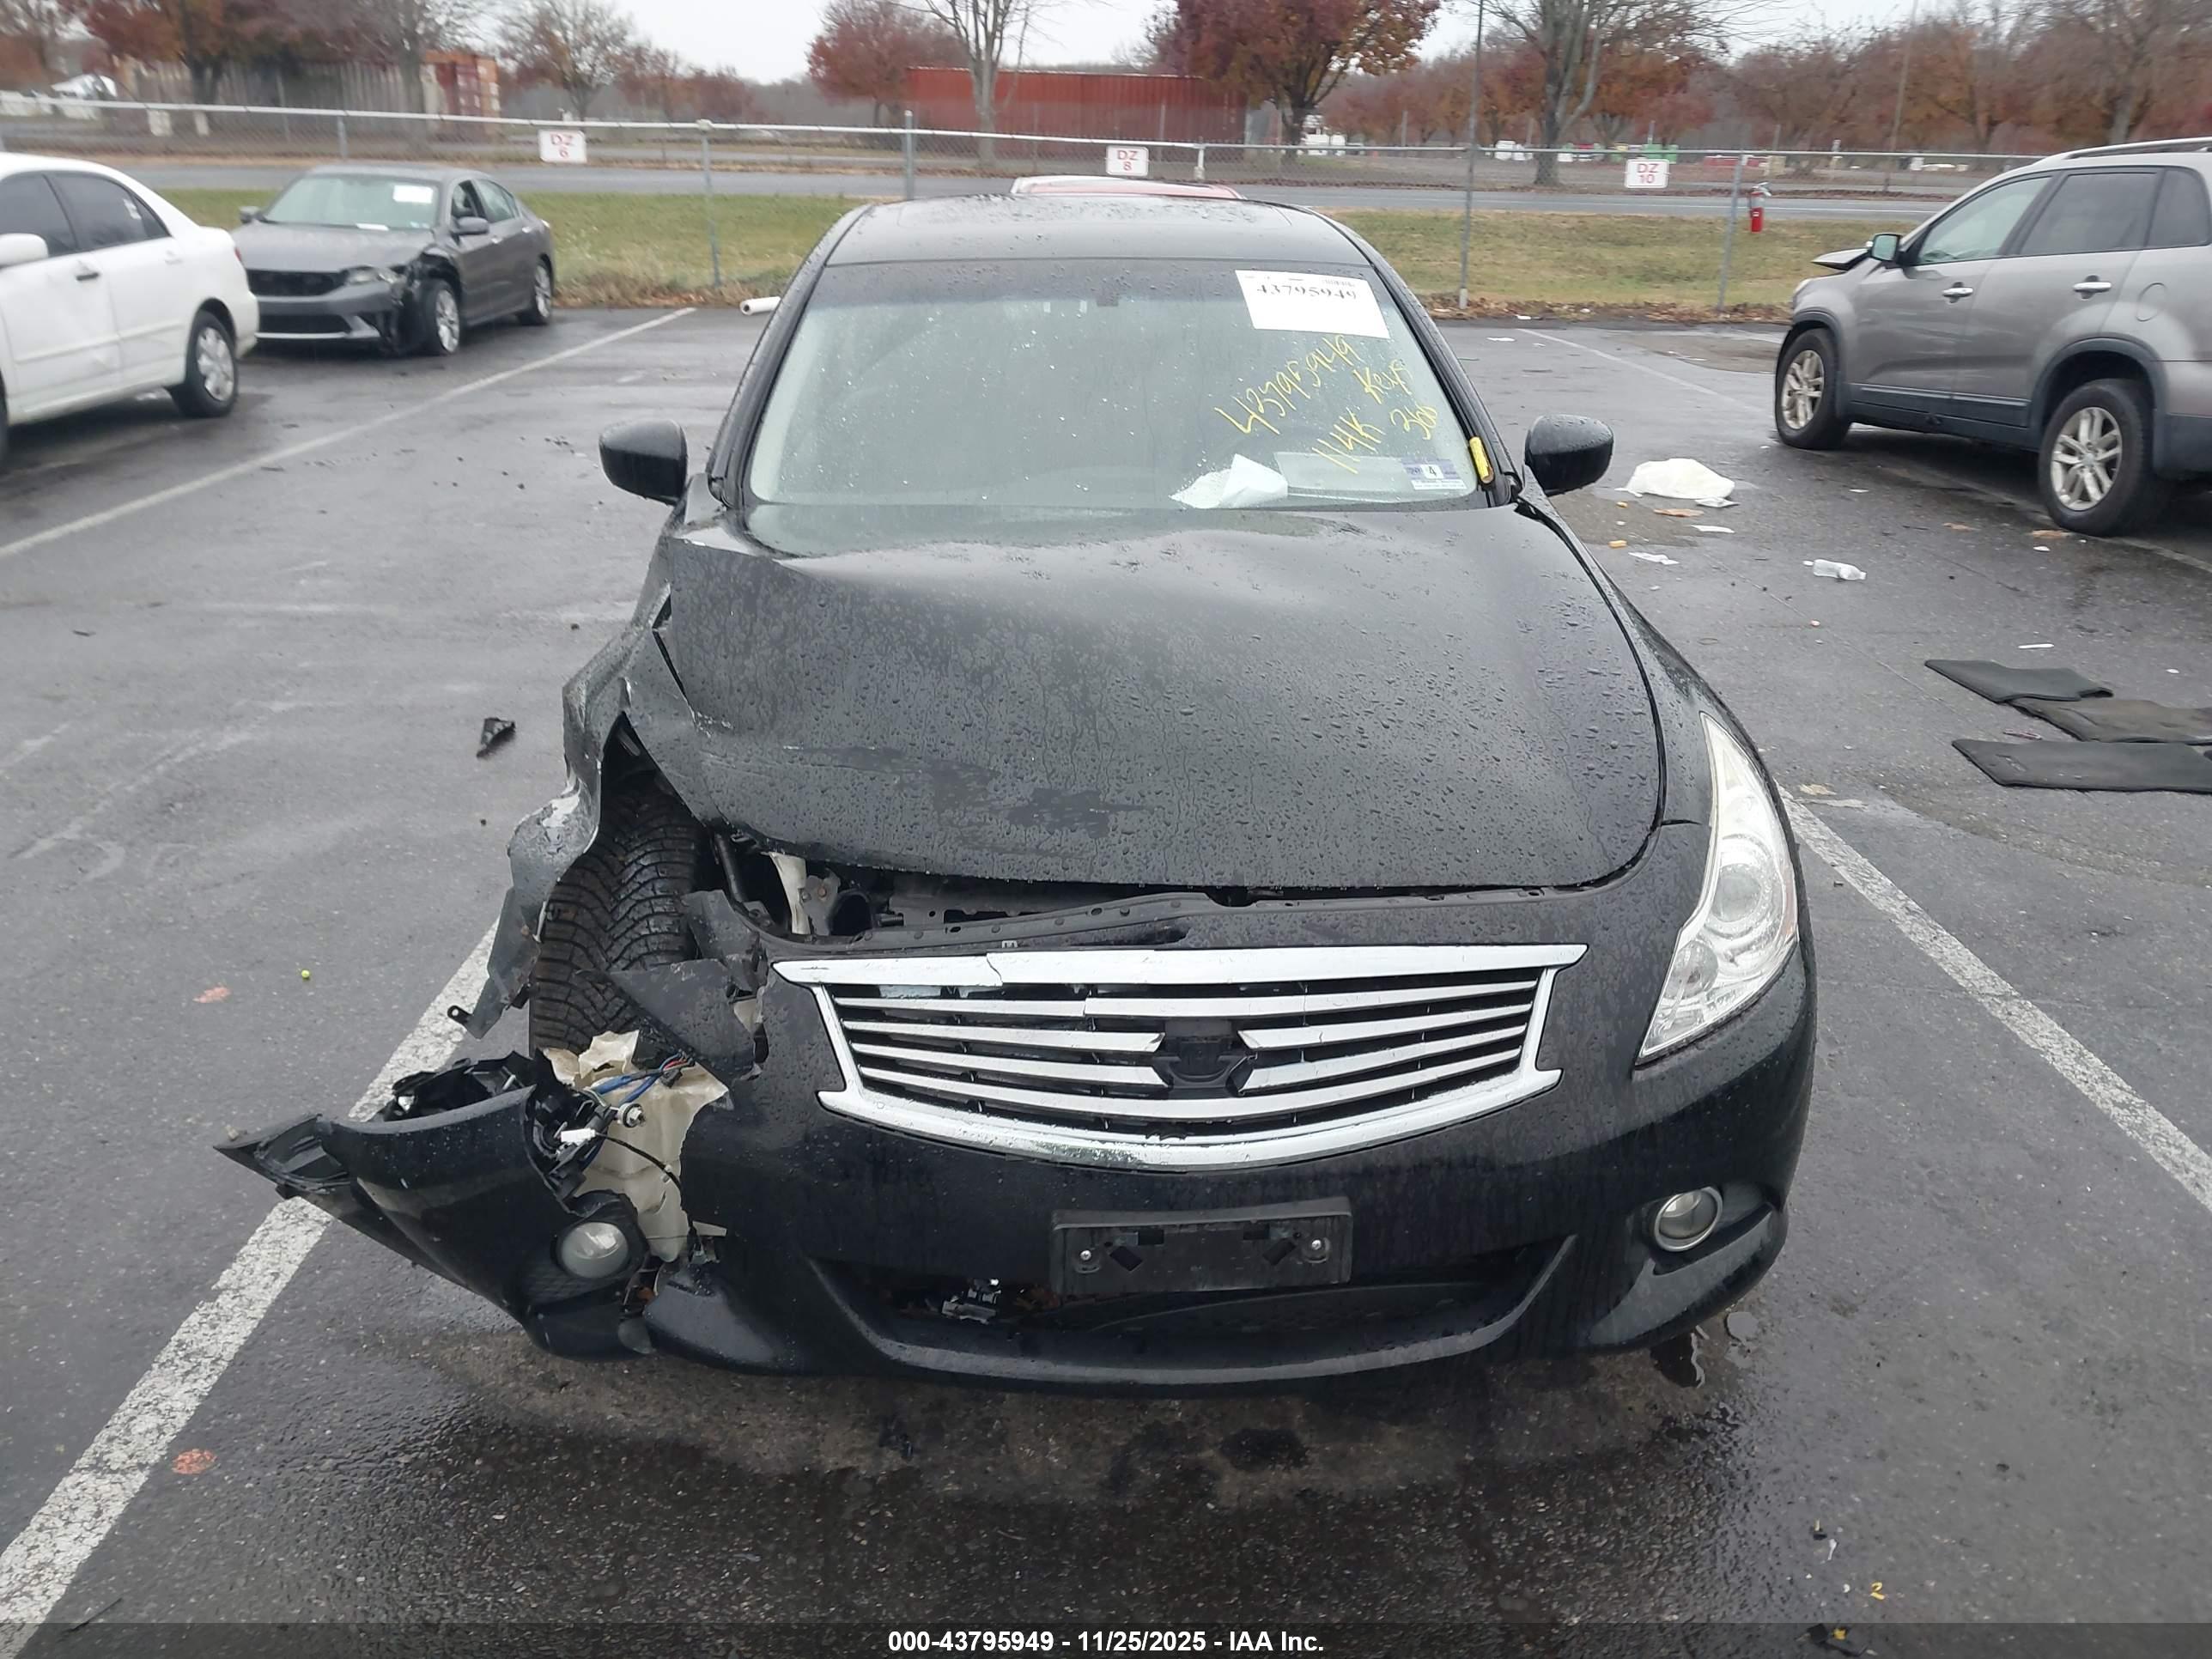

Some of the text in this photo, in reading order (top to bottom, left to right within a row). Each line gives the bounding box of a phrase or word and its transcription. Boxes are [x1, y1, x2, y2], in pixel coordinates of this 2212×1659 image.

[1117, 149, 1139, 161] DZ
[1123, 161, 1132, 171] 8
[1638, 163, 1658, 173] DZ
[1639, 173, 1655, 184] 10
